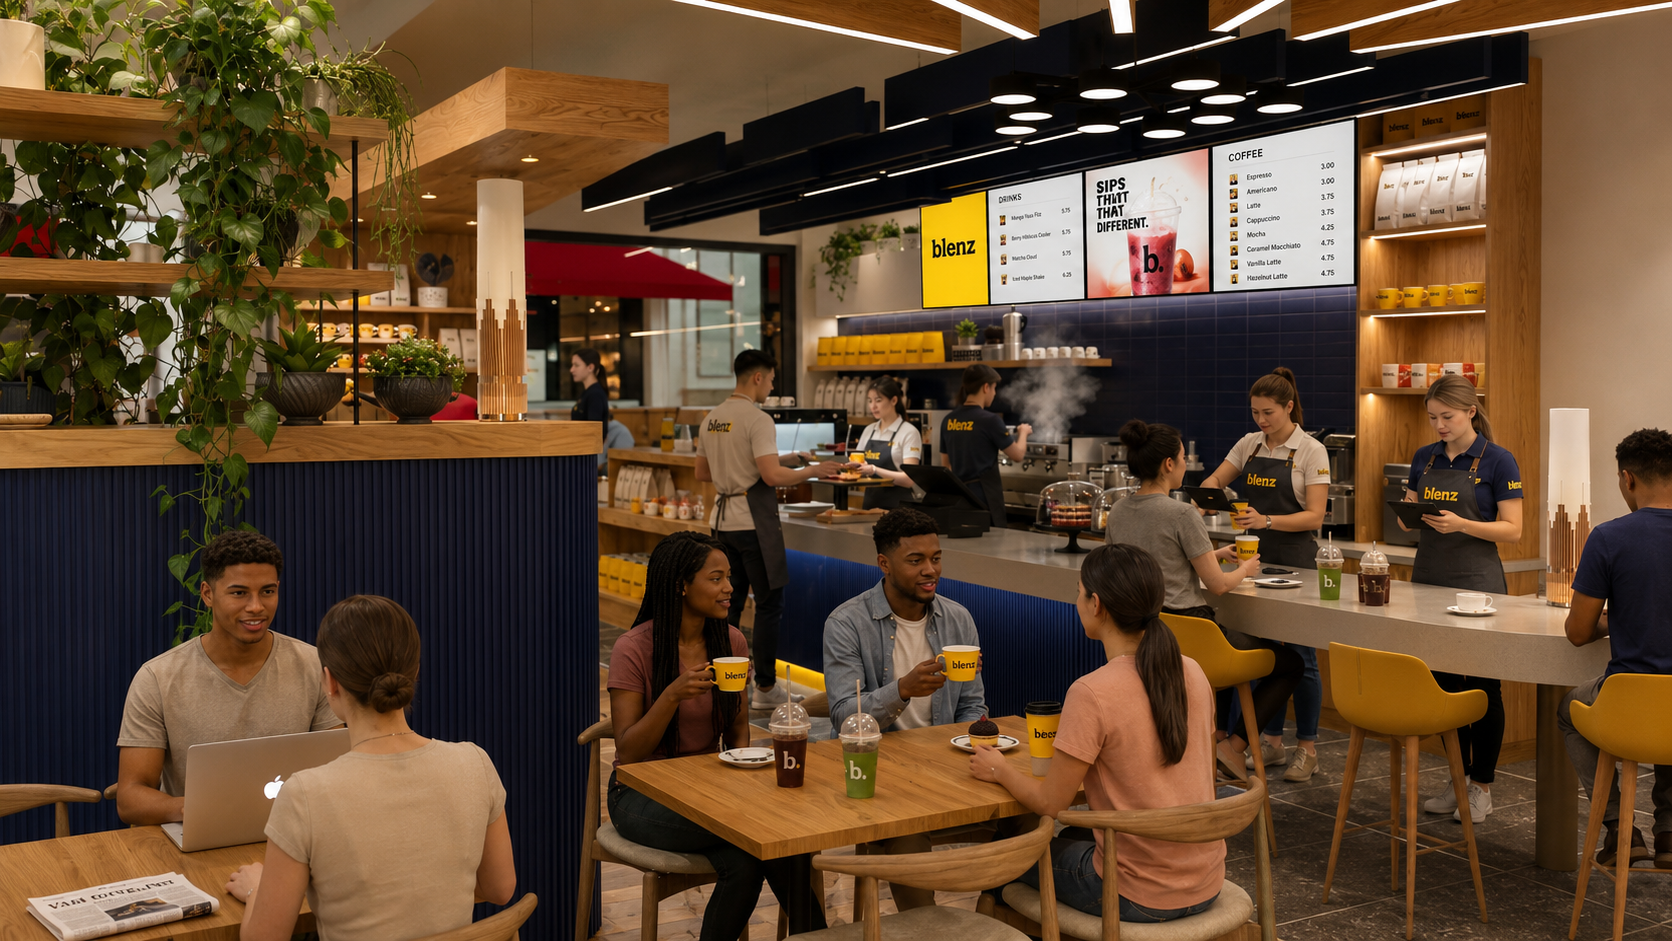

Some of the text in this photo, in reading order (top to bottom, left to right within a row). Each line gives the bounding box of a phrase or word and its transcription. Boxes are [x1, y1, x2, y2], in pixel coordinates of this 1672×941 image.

[1228, 148, 1263, 162] COFFEE
[1320, 162, 1335, 170] 3.00
[1096, 177, 1126, 194] SIPS
[1246, 177, 1335, 195] Americano 3.00
[998, 193, 1022, 204] DRINKS
[1246, 193, 1335, 210] Latte 3.75
[1096, 204, 1124, 219] THAT
[1246, 208, 1335, 225] Cappuccino 3.75
[1097, 216, 1149, 233] DIFFERENT.
[1246, 231, 1266, 239] Mocha
[931, 237, 976, 258] blenz
[1270, 242, 1301, 251] Macchiato
[1142, 244, 1164, 273] b.
[1246, 259, 1265, 267] Vanilla
[1266, 258, 1281, 266] Latte
[1272, 272, 1288, 280] Latte
[1320, 269, 1335, 277] 4.75
[707, 418, 732, 433] blenz
[946, 418, 974, 431] blenz
[1247, 473, 1277, 488] blenz
[1424, 486, 1459, 502] blenz
[1323, 574, 1336, 588] b.
[782, 750, 801, 770] b.
[849, 760, 867, 781] b.
